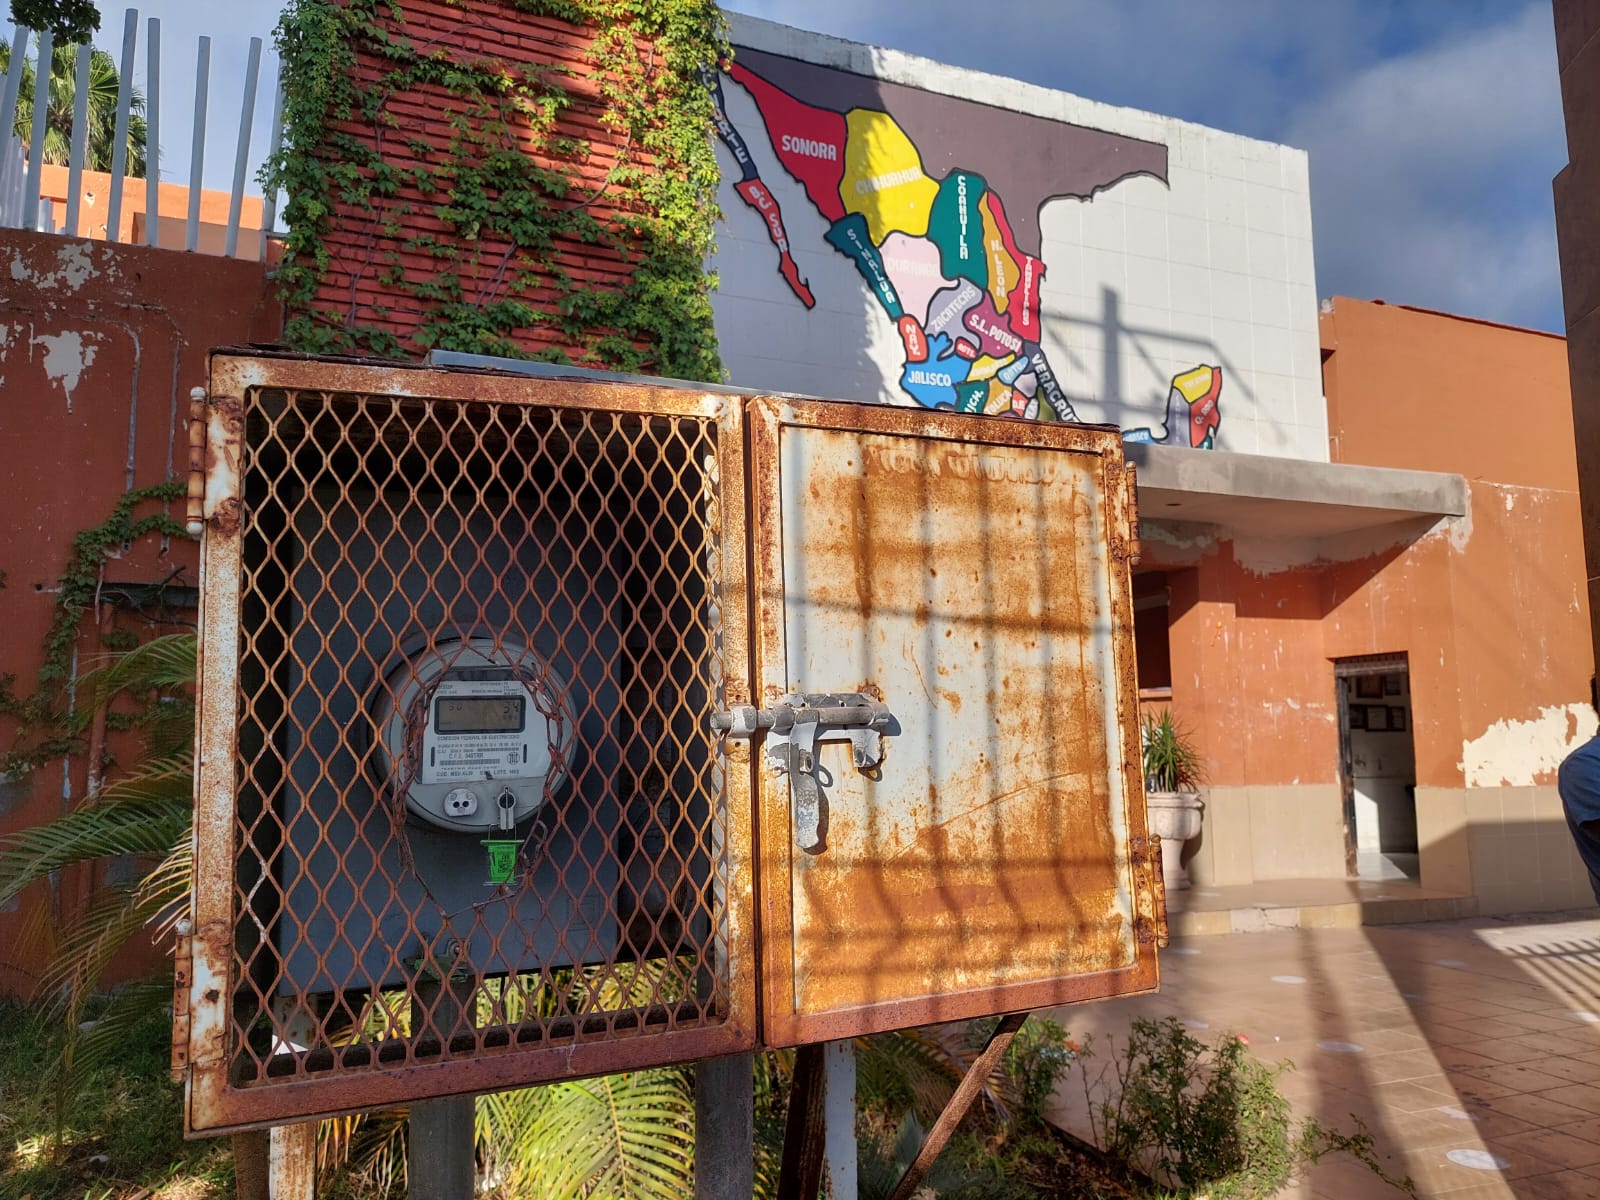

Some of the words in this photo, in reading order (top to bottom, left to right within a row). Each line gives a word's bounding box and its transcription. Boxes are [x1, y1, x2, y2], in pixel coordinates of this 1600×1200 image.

[782, 135, 837, 161] SONORA
[768, 212, 788, 254] SUR
[956, 174, 969, 260] COAHUILA
[846, 228, 896, 304] SINALOA
[993, 253, 1005, 297] LEON
[931, 286, 977, 332] ZACATECAS
[905, 324, 921, 355] NAY.
[988, 325, 1022, 353] POTOSI
[908, 371, 952, 387] JALISCO
